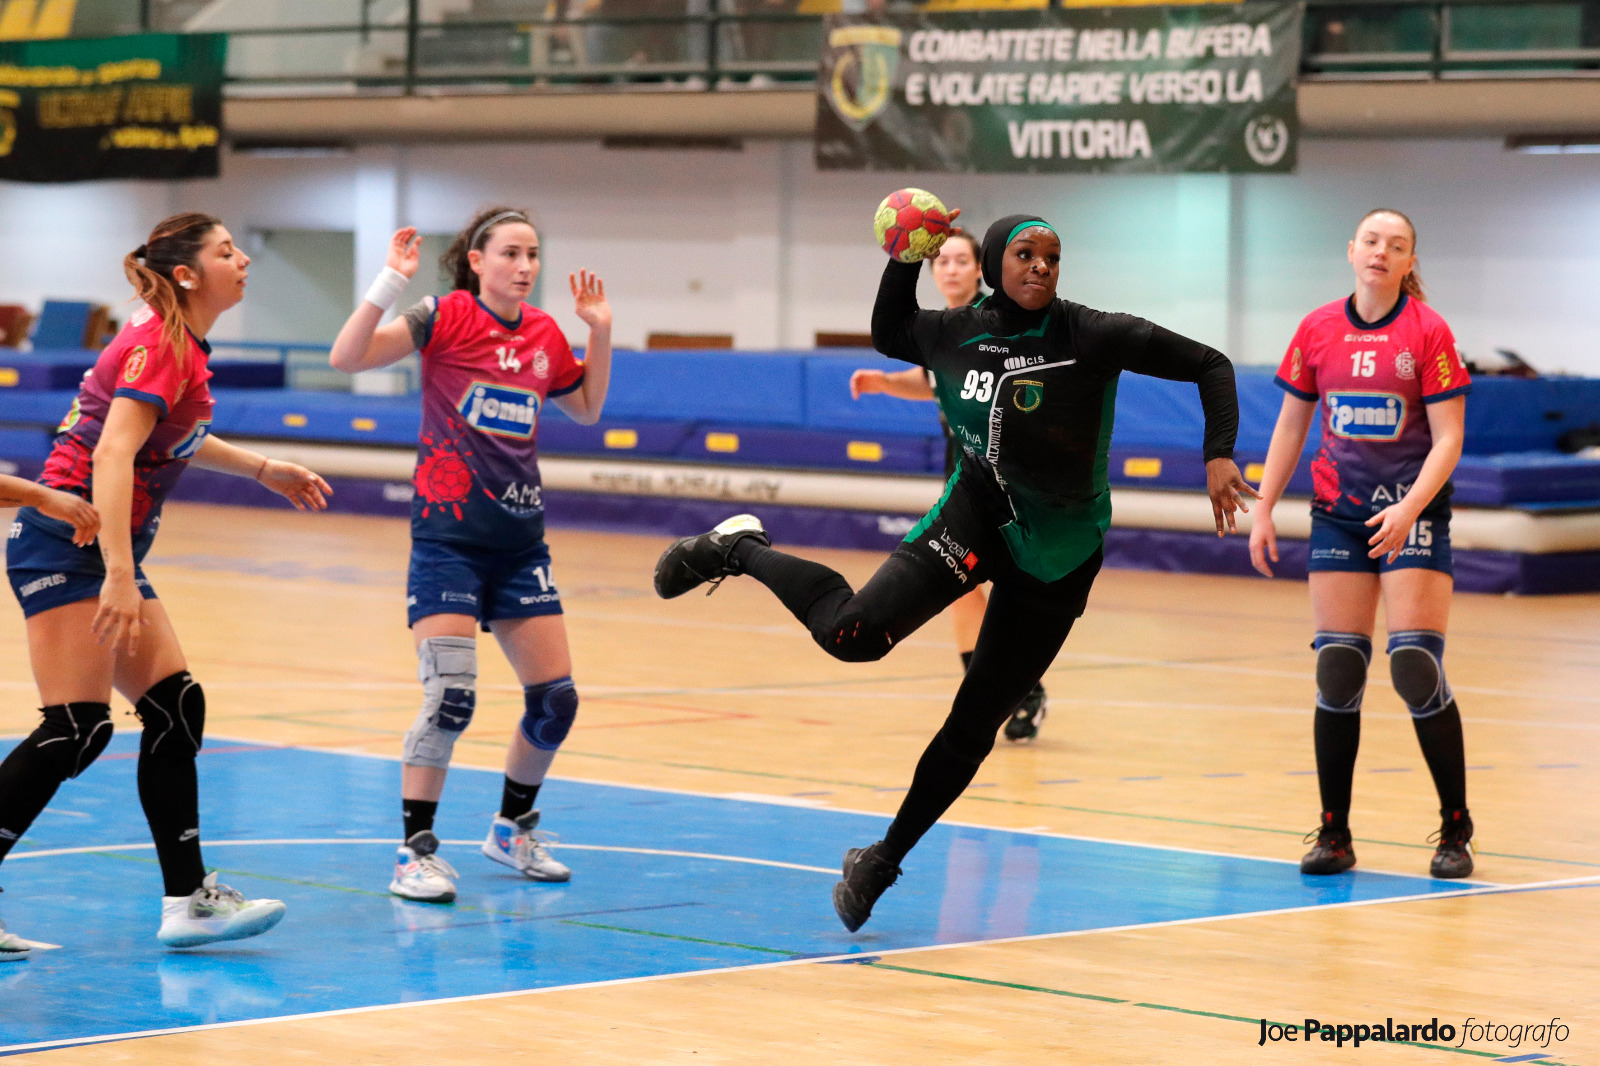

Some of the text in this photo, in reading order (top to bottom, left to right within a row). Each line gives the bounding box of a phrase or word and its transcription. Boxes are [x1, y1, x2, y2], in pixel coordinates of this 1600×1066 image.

[908, 23, 1272, 62] COMBATTETE NELLA BUFERA
[905, 69, 1264, 105] E VOLATE RAPIDE VERSO LA
[1007, 118, 1152, 159] VITTORIA
[495, 346, 522, 373] 14
[978, 344, 1010, 354] GIVOVA
[1350, 350, 1376, 377] 15
[960, 369, 994, 403] 93
[467, 387, 535, 427] jomi
[1408, 521, 1433, 547] 15
[928, 539, 968, 584] GIVOVA
